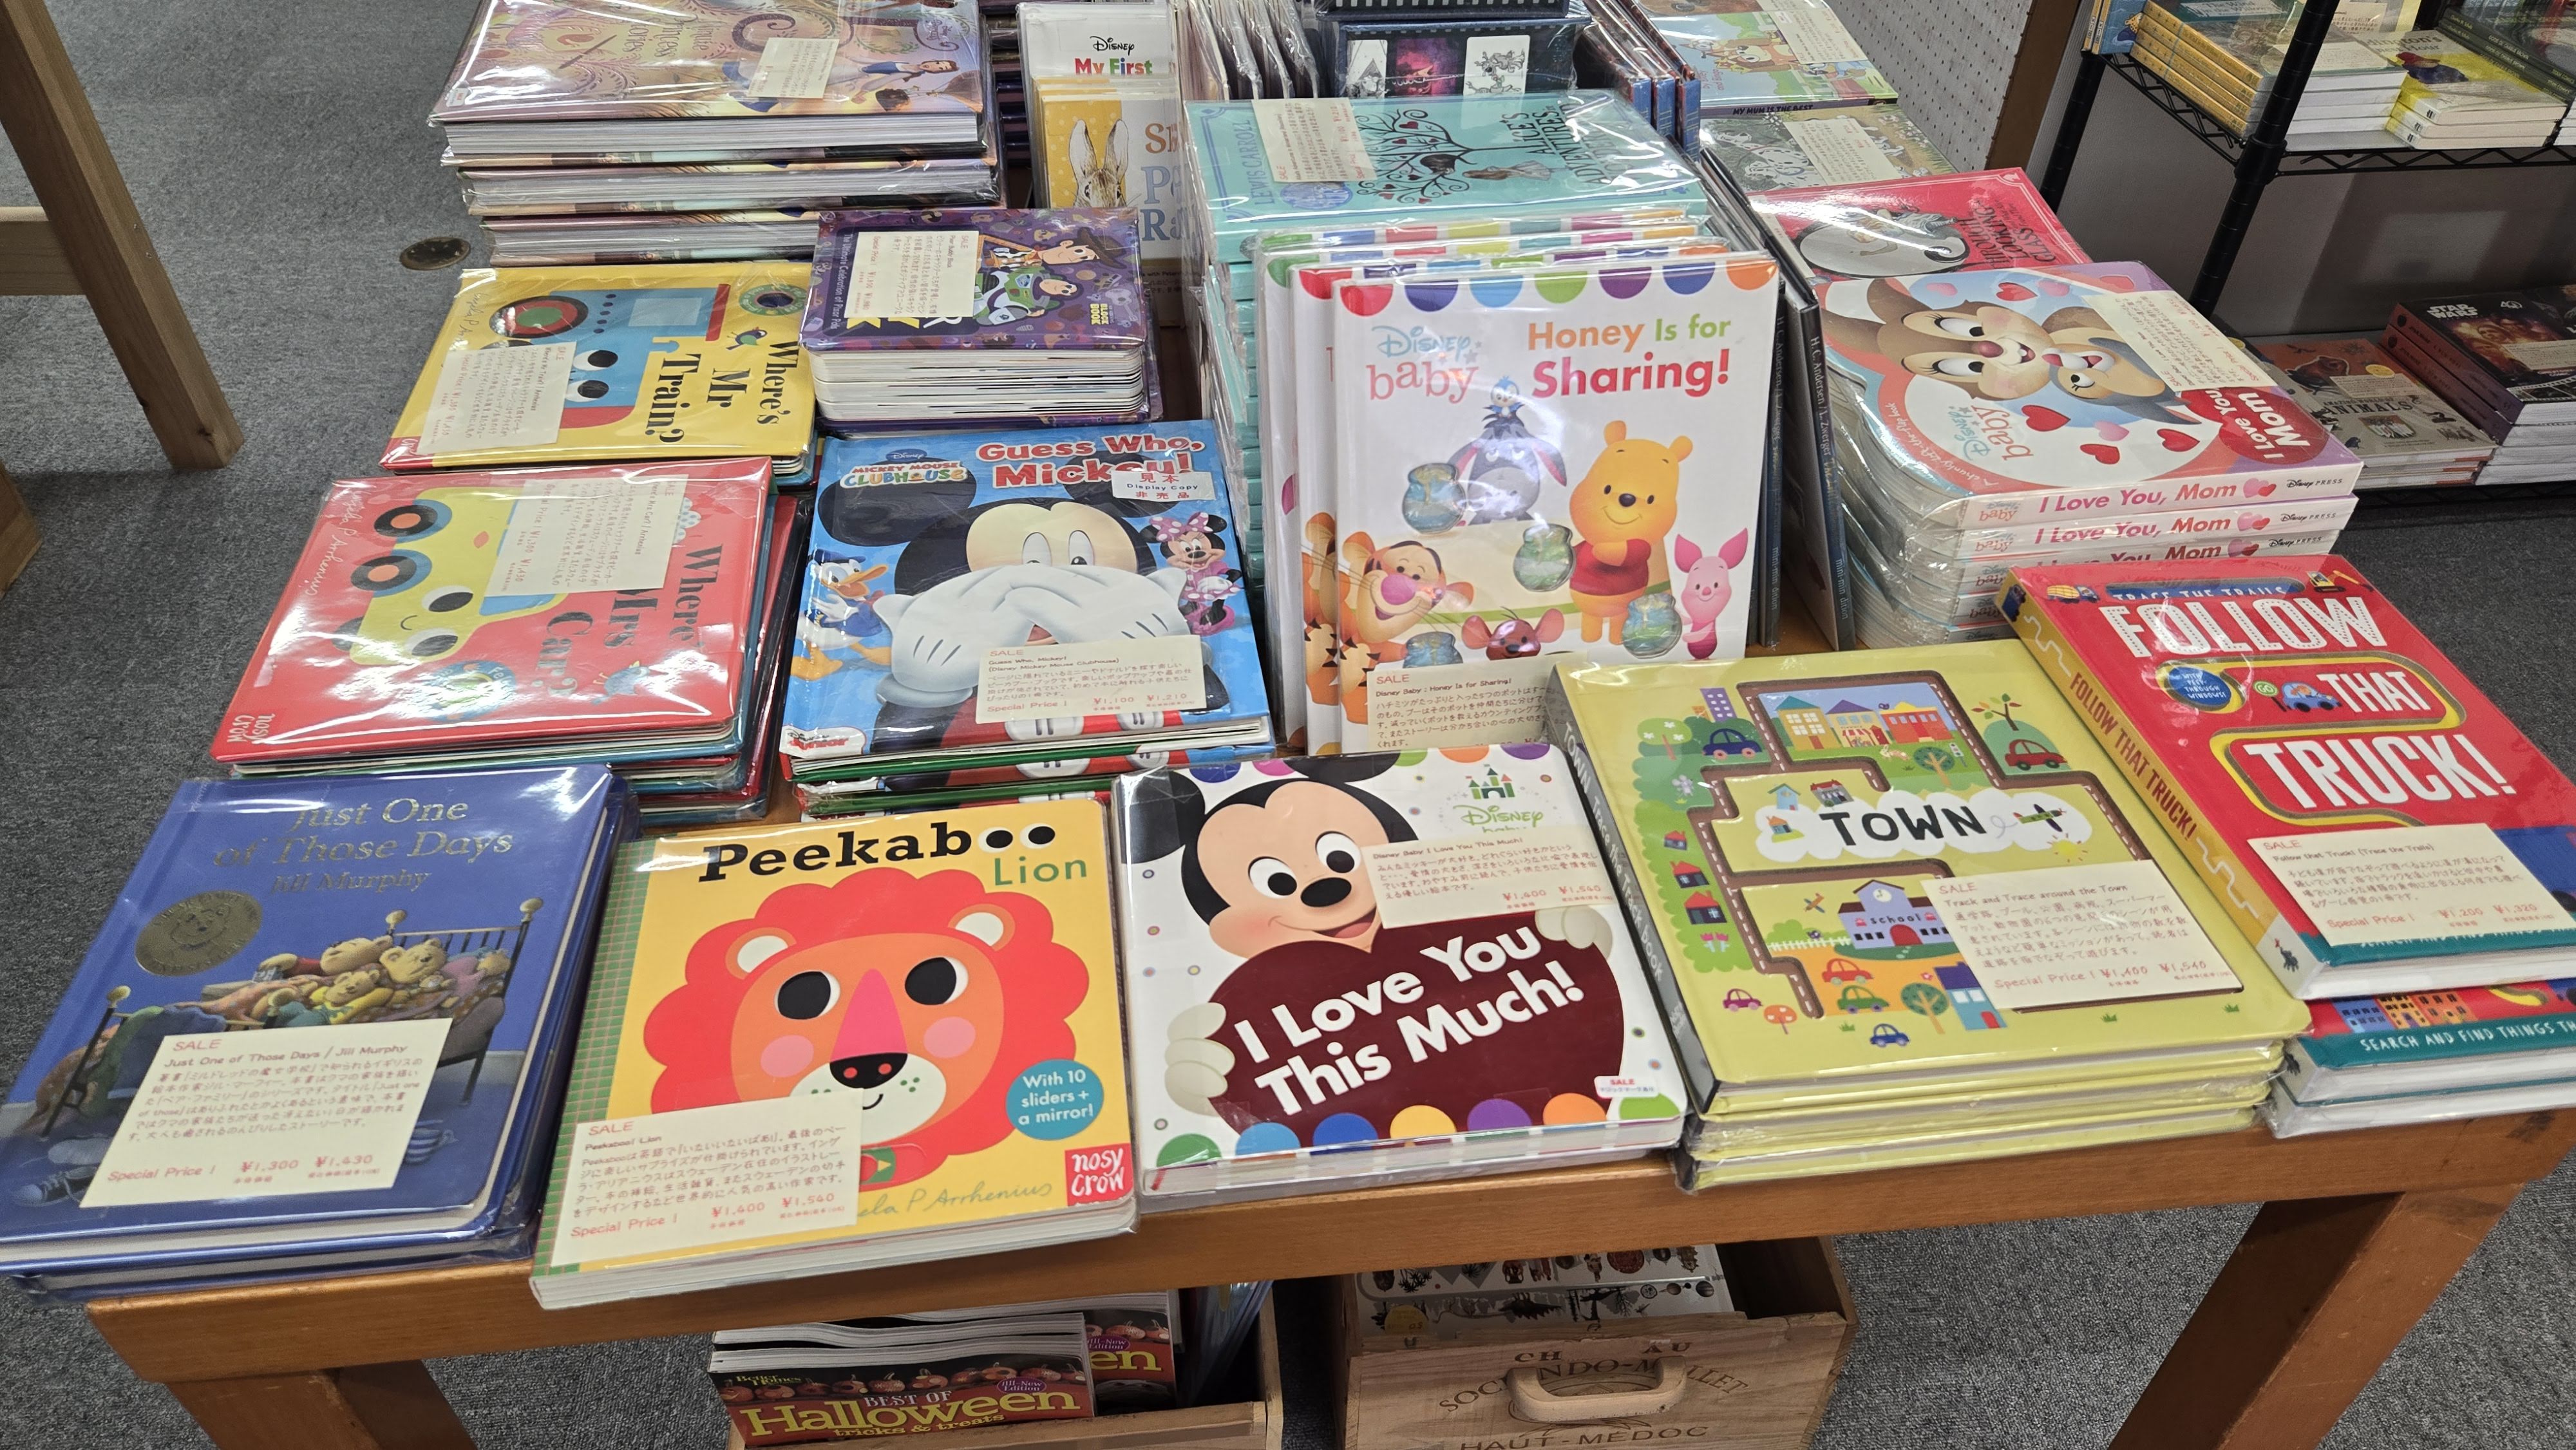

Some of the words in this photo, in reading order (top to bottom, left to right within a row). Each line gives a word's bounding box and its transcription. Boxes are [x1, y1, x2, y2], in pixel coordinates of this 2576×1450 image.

[1090, 36, 1135, 56] Disney
[1075, 58, 1105, 75] My
[1110, 58, 1153, 75] First
[1776, 105, 1792, 113] THE
[1792, 104, 1814, 113] BEST
[1234, 120, 1263, 168] CARROLL
[1501, 112, 1556, 155] ALICE'S
[1248, 170, 1274, 205] LEWIS
[844, 234, 854, 242] The
[960, 235, 969, 248] SALE
[2016, 227, 2056, 263] GLASS
[841, 243, 853, 265] Ultimate
[836, 265, 849, 296] Celebration
[833, 304, 843, 319] Pixar
[1090, 303, 1101, 325] BOOK
[1101, 303, 1109, 325] BLOCK
[2427, 303, 2472, 313] STAR
[1528, 321, 1645, 353] Honey
[1656, 319, 1677, 342] Is
[1689, 314, 1732, 341] for
[758, 340, 800, 425] Where's
[1367, 360, 1479, 404] baby
[1533, 348, 1731, 398] Sharing!
[645, 353, 703, 444] Train?
[705, 368, 751, 408] Mr
[2205, 388, 2237, 415] You
[2324, 401, 2412, 415] ANIMALS
[1971, 405, 2034, 460] baby
[2239, 393, 2311, 446] Mom
[1948, 411, 1991, 460] Disney
[2235, 418, 2275, 450] Love
[977, 442, 1095, 462] Guess
[1104, 434, 1206, 454] Who,
[844, 467, 968, 487] CLUBHOUSE
[852, 462, 917, 475] MICKEY
[920, 460, 962, 472] MOUSE
[1139, 473, 1179, 484] 見本
[2286, 479, 2313, 488] Disney
[2039, 496, 2049, 513] I
[2054, 495, 2109, 513] Love
[2121, 489, 2166, 505] You,
[2175, 484, 2237, 501] Mom
[1979, 508, 2018, 522] baby
[2280, 513, 2307, 522] Disney
[2035, 528, 2045, 544] I
[2050, 527, 2104, 543] Love
[2115, 522, 2161, 538] You,
[2172, 517, 2231, 533] Mom
[2268, 539, 2295, 547] Disney
[1975, 540, 2014, 552] baby
[609, 588, 656, 648] Mrs
[2099, 596, 2387, 659] FOLLOW
[531, 611, 593, 696] Car?
[1376, 673, 1409, 684] SALE
[2259, 684, 2274, 694] GO
[2318, 670, 2432, 713] THAT
[227, 714, 251, 744] crow
[1377, 739, 1408, 748] くれます。
[2070, 672, 2119, 750] FOLLOW
[2114, 738, 2152, 787] THAT
[2145, 768, 2197, 842] TRUCK!
[2243, 734, 2517, 810] TRUCK!
[292, 798, 370, 833] Just
[382, 798, 469, 824] One
[1820, 805, 1987, 847] TOWN
[214, 836, 267, 868] of
[274, 834, 398, 866] Those
[409, 831, 514, 866] Days
[2261, 840, 2303, 850] SALE
[271, 871, 309, 896] Jill
[321, 868, 433, 894] Murphy
[994, 856, 1089, 887] Lion
[1501, 889, 1547, 901] ¥1,400
[1558, 882, 1601, 896] ¥1,540
[1935, 883, 1979, 894] SALE
[1870, 912, 1921, 925] school
[2324, 916, 2371, 929] Special
[2370, 914, 2407, 924] Price
[2436, 907, 2486, 919] ¥1,200
[2492, 903, 2539, 914] ¥1,320
[1991, 975, 2045, 990] Special
[2047, 972, 2087, 983] Price
[2098, 965, 2151, 979] ¥1,400
[2157, 959, 2208, 972] ¥1,540
[1233, 1019, 1269, 1063] I
[1272, 970, 1425, 1048] Love
[1419, 926, 1542, 983] You
[171, 1039, 223, 1051] SALE
[1255, 1041, 1392, 1116] This
[1396, 962, 1585, 1064] Much!
[2360, 1035, 2420, 1052] SEARCH
[2426, 1032, 2454, 1046] AND
[2459, 1028, 2495, 1042] FIND
[2501, 1021, 2555, 1040] THINGS
[163, 1057, 196, 1068] Just
[198, 1055, 225, 1065] One
[227, 1055, 244, 1064] of
[247, 1052, 287, 1062] Those
[289, 1050, 321, 1060] Days
[334, 1048, 355, 1057] Jill
[357, 1044, 409, 1057] Murphy
[1023, 1071, 1064, 1090] With
[1069, 1069, 1086, 1084] 10
[1021, 1089, 1073, 1109] sliders
[1018, 1113, 1028, 1127] a
[1031, 1103, 1095, 1126] mirror!
[588, 1121, 634, 1136] SALE
[585, 1138, 635, 1151] Peekaboo!
[639, 1135, 662, 1144] Lion
[106, 1168, 160, 1183] Special
[162, 1165, 205, 1178] Price
[238, 1157, 301, 1172] ¥1,300
[312, 1153, 375, 1168] ¥1,430
[1073, 1151, 1123, 1177] nosy
[1071, 1170, 1126, 1196] crow
[570, 1221, 621, 1239] Special
[627, 1214, 665, 1229] Price
[711, 1200, 765, 1218] ¥1,400
[781, 1191, 835, 1208] ¥1,540
[864, 1393, 918, 1408] BEST
[926, 1391, 952, 1405] OF
[1003, 1384, 1035, 1393] Edition
[739, 1391, 1081, 1438] Halloween
[835, 1425, 908, 1437] tricks
[911, 1423, 931, 1434] &
[935, 1414, 1005, 1429] treats
